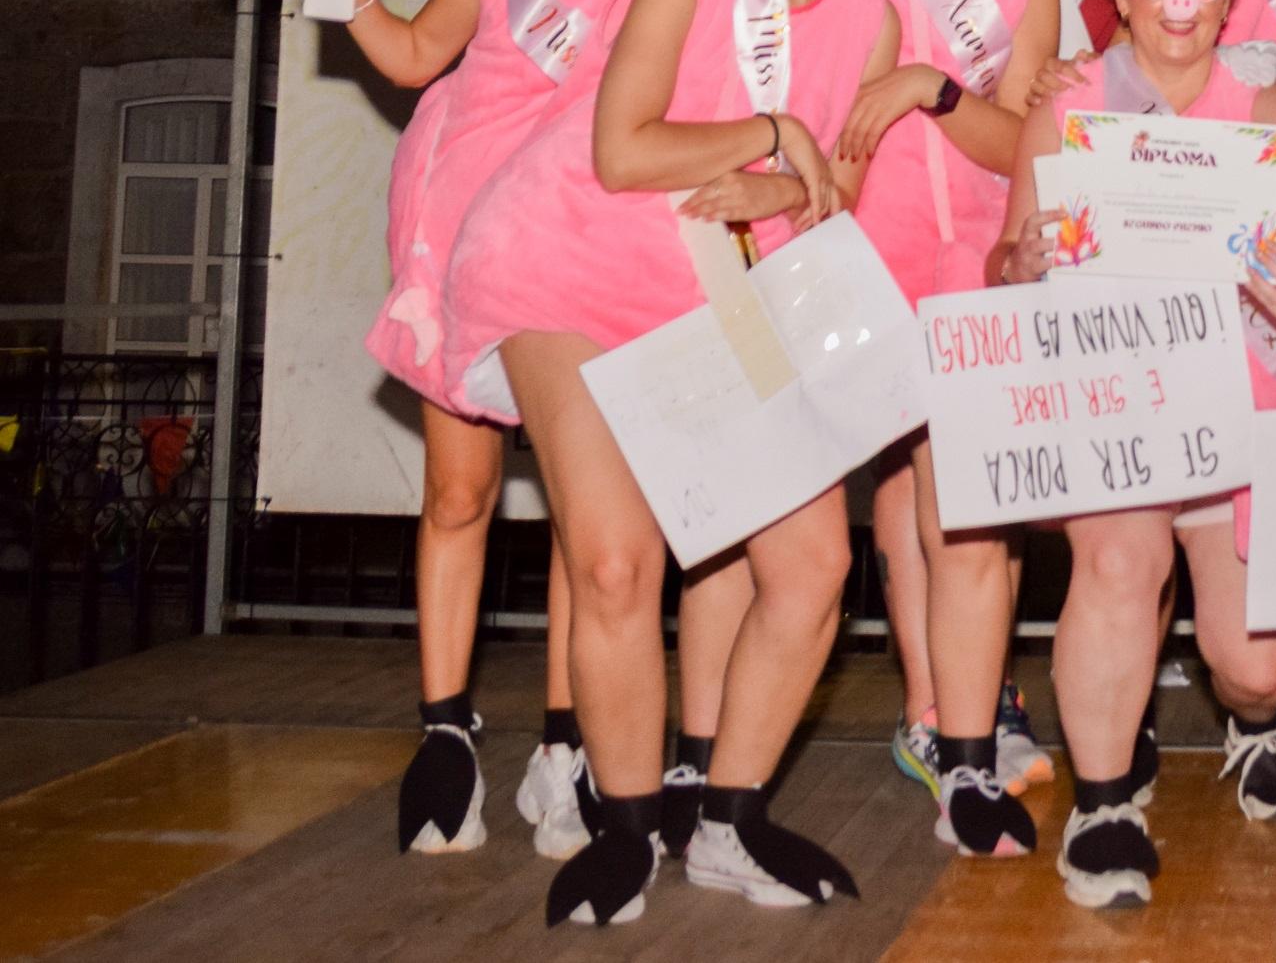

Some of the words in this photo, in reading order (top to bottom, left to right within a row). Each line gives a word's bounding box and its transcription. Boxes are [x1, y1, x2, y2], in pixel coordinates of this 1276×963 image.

[1130, 147, 1218, 168] DIPLOMA
[1032, 310, 1061, 360] AS
[1072, 301, 1156, 358] VIVAN
[1077, 373, 1127, 418] SER
[983, 443, 1069, 507] PORCA
[1090, 435, 1152, 492] SER
[1180, 426, 1219, 479] SE
